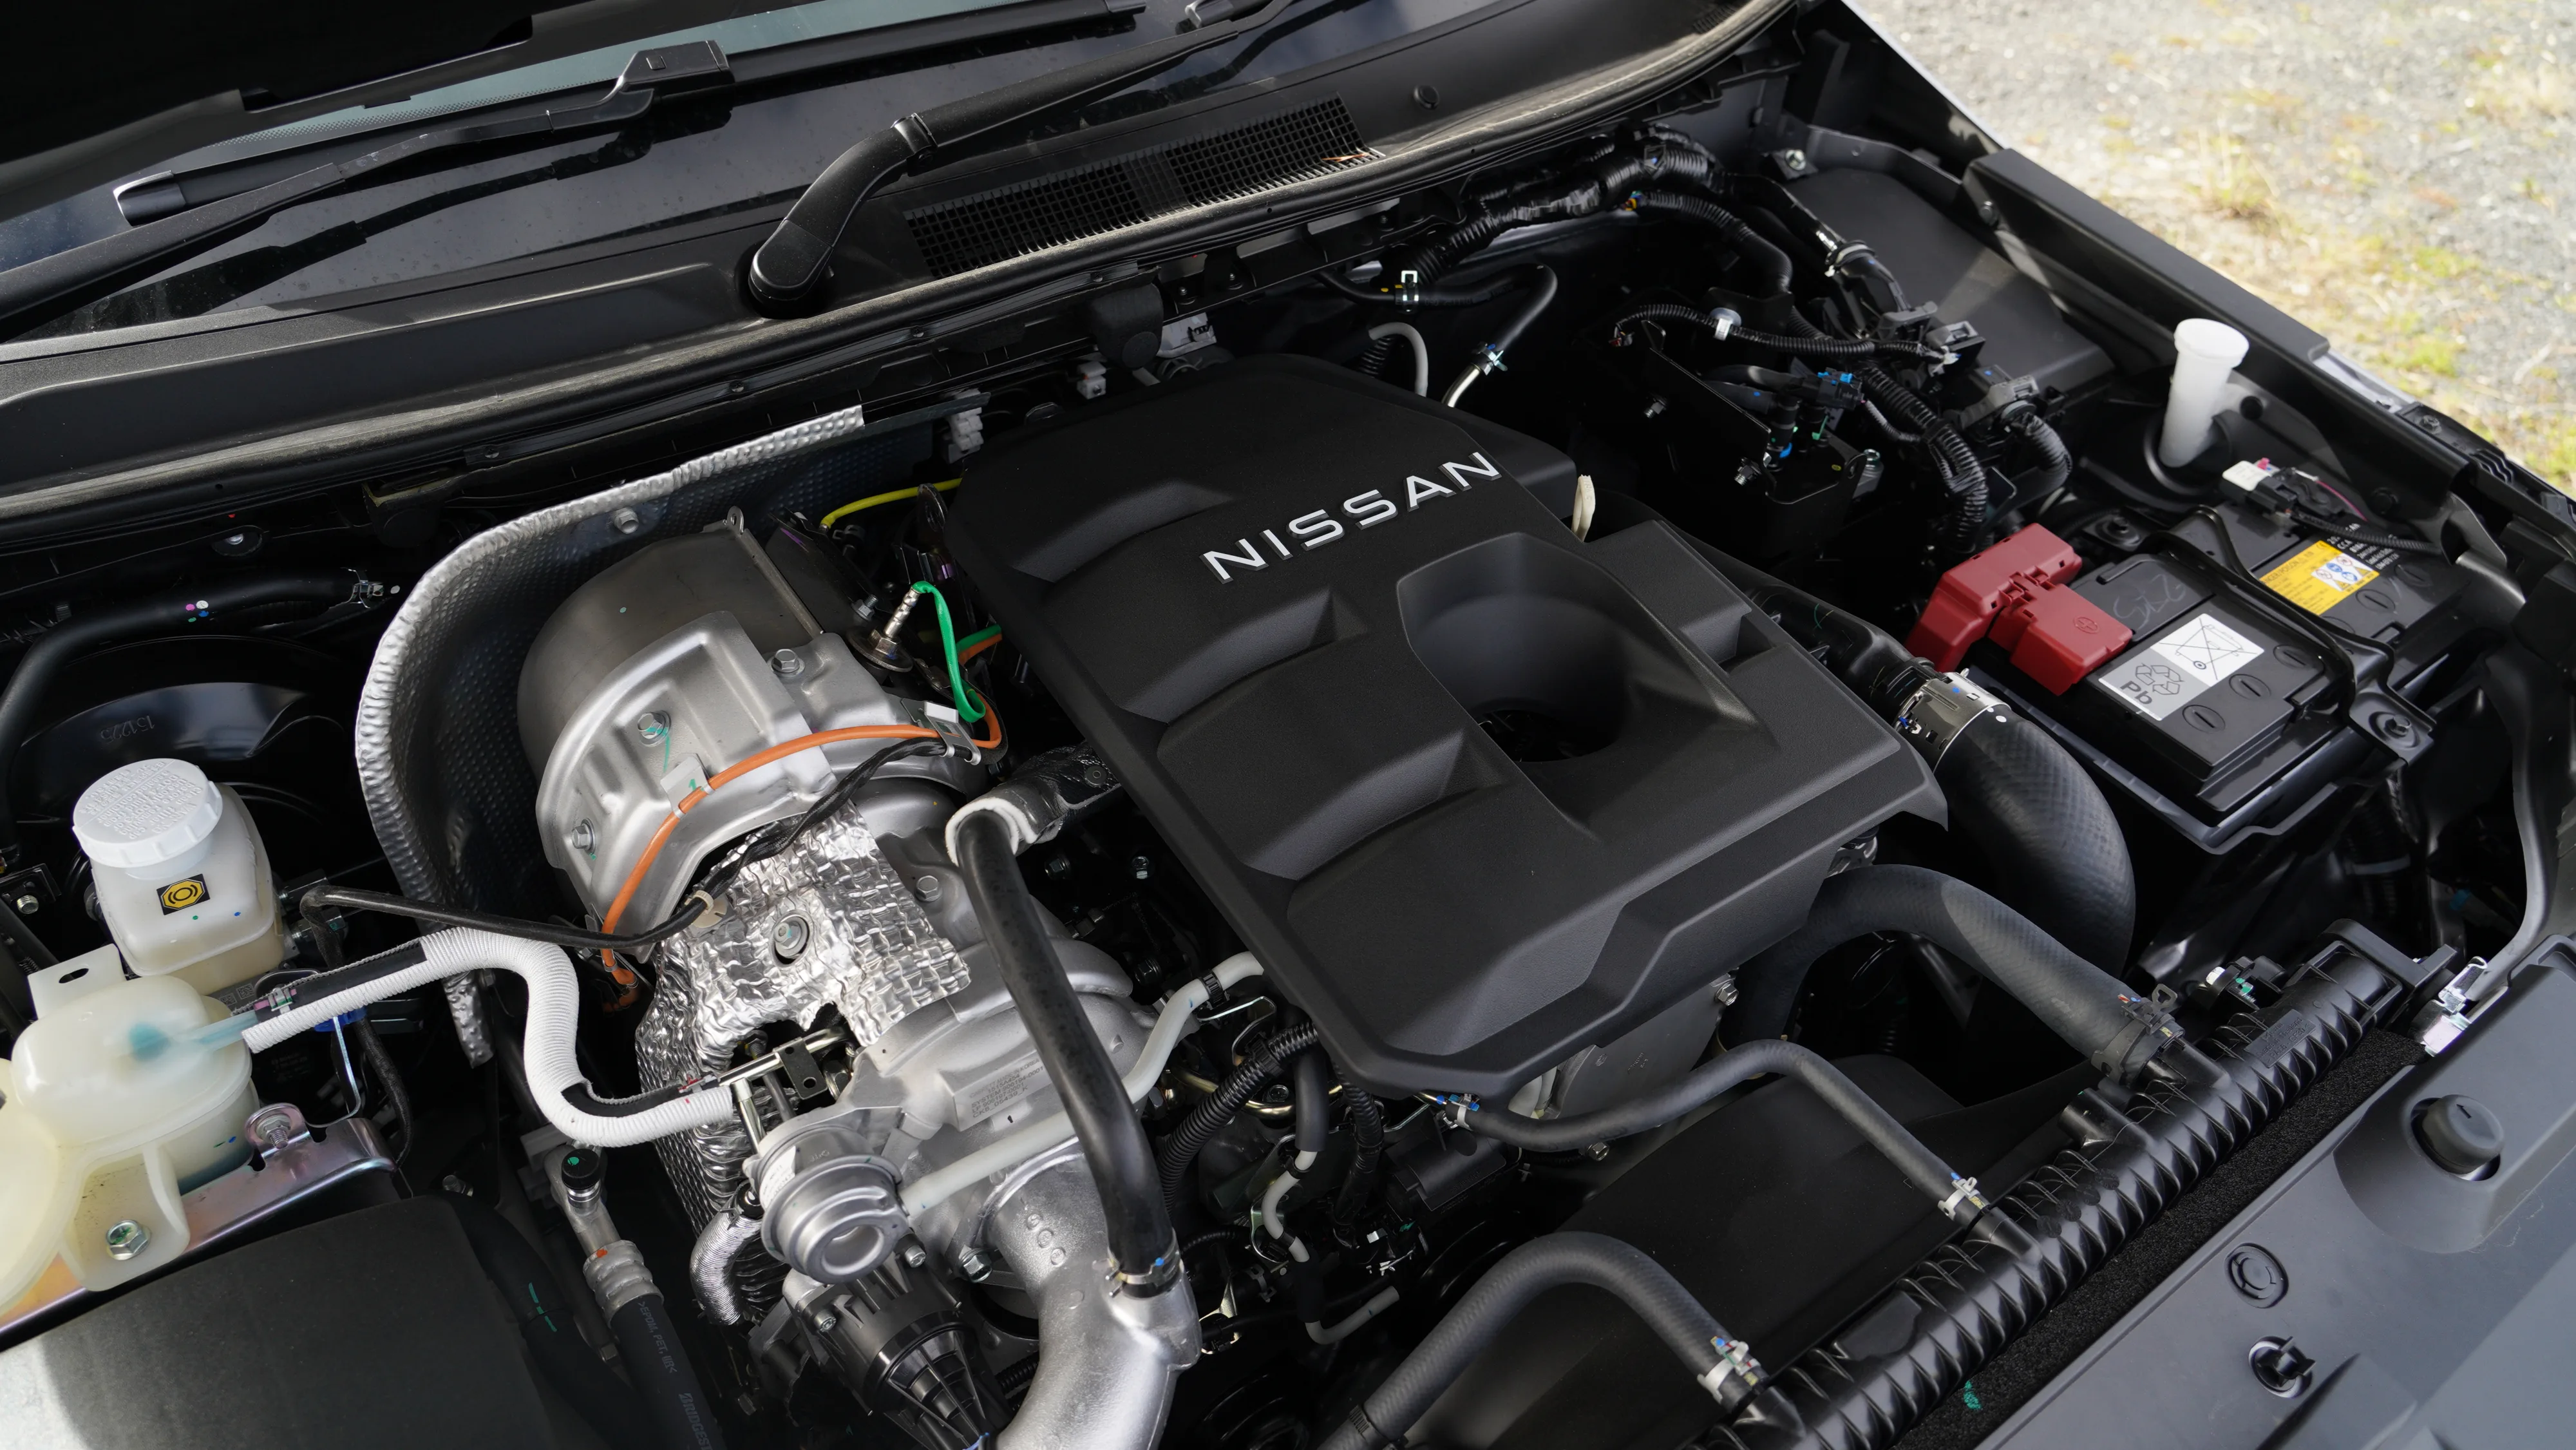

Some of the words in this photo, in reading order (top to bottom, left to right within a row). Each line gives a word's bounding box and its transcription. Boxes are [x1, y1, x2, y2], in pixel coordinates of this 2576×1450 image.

[1199, 451, 1502, 584] NISSAN
[2119, 680, 2154, 706] Pb
[161, 781, 194, 806] before
[167, 777, 187, 792] Use
[175, 785, 203, 806] Clean
[126, 825, 147, 840] cap
[1020, 1058, 1040, 1072] KOREA
[971, 1089, 1001, 1108] SYSTEM
